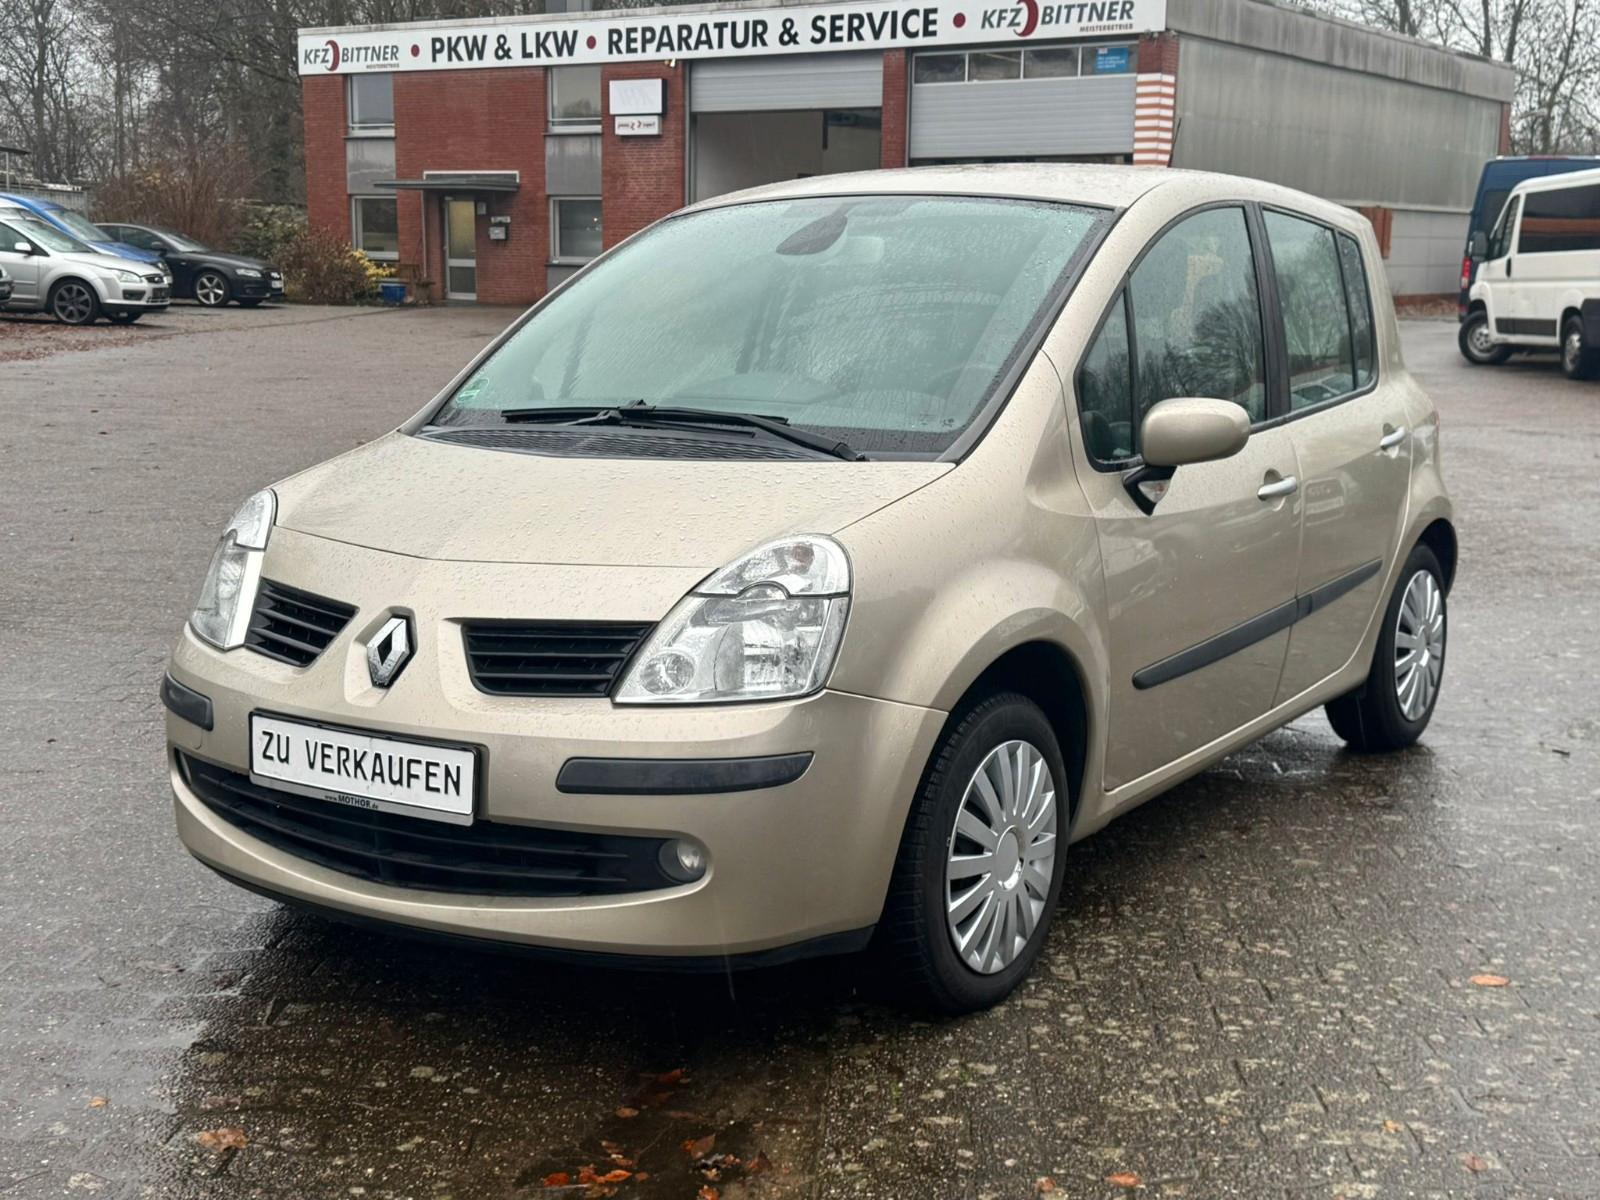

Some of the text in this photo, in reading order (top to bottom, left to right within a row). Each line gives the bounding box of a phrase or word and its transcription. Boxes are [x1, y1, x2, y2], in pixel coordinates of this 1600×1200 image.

[431, 7, 939, 63] PKW & LKW REPARATUR & SERVICE
[980, 1, 1135, 30] KFZ BITTNER
[303, 44, 399, 65] KFZ BITTNER
[261, 730, 462, 797] ZU VERKAUFEN
